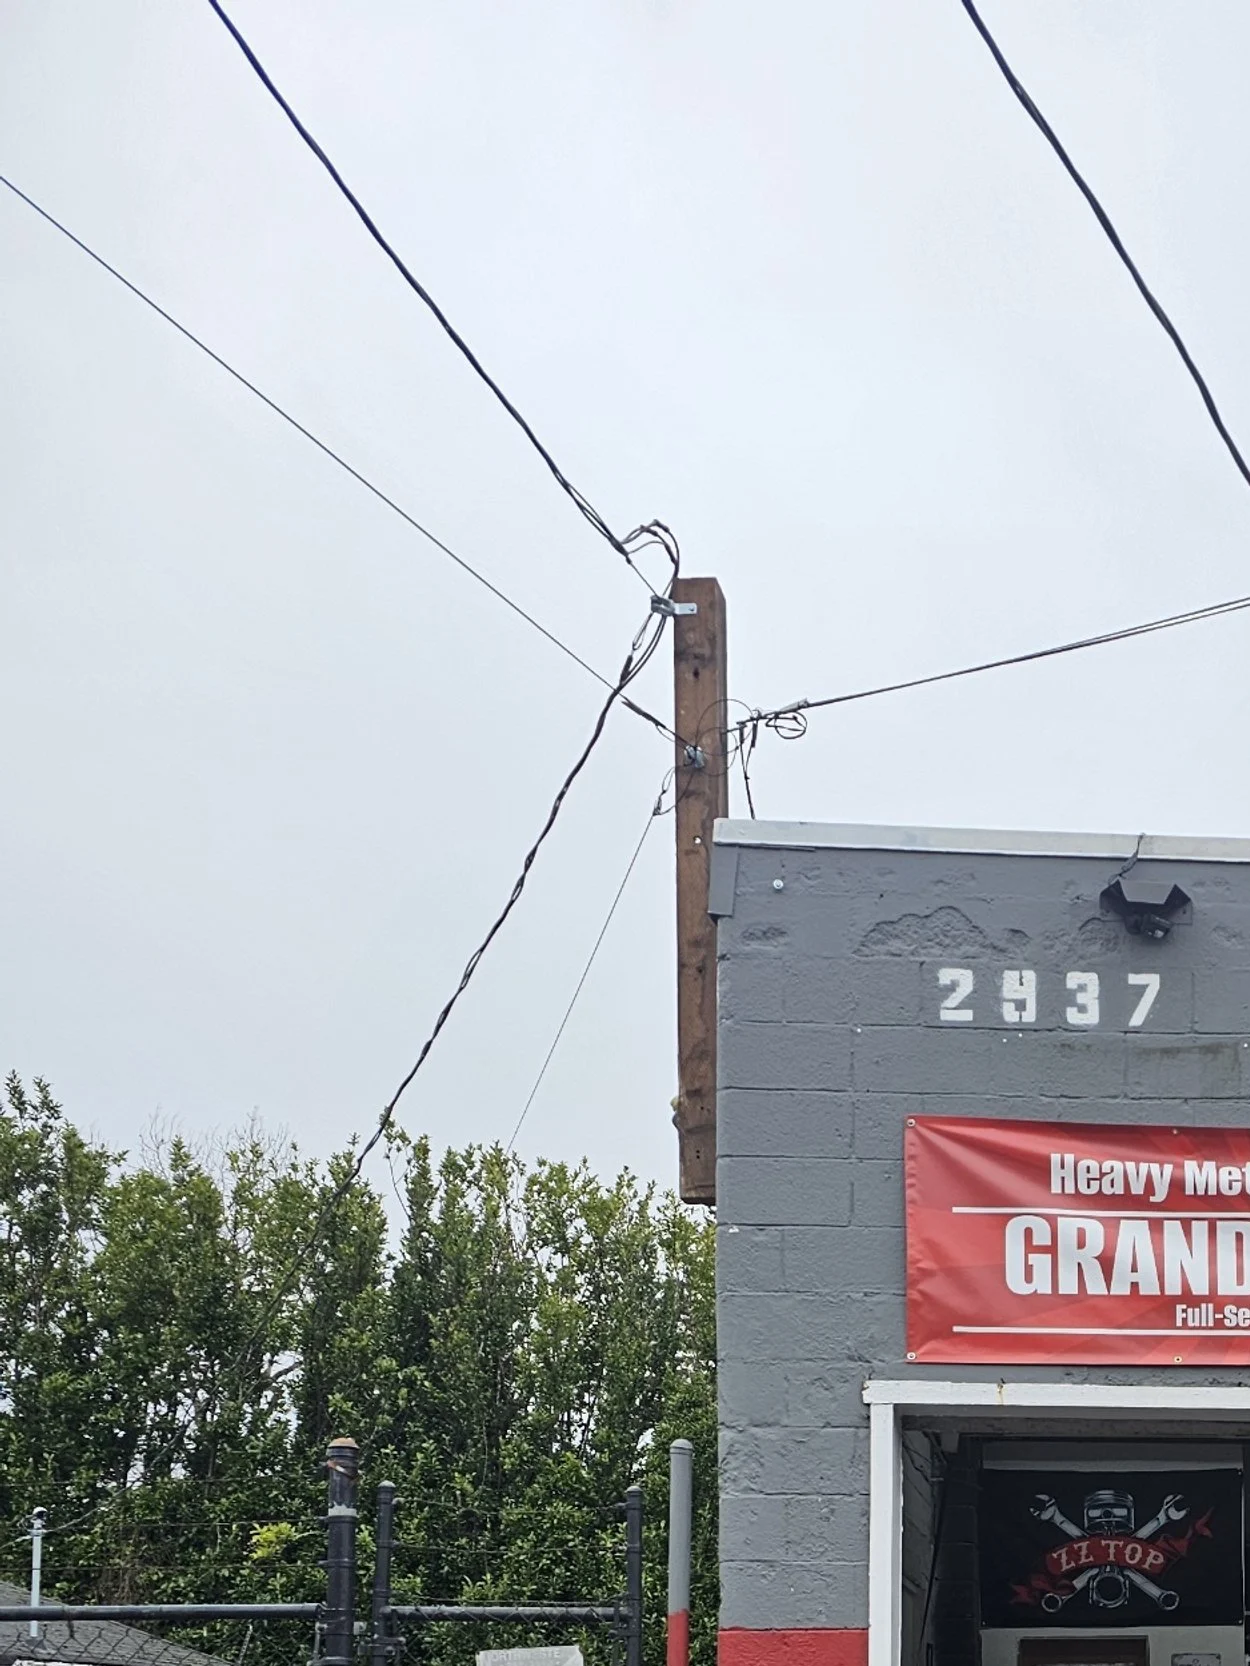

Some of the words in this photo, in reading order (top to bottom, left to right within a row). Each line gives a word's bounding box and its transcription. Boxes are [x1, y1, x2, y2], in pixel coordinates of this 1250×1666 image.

[937, 968, 1160, 1027] 2937
[1049, 1152, 1174, 1203] Heavy
[1052, 1541, 1094, 1573] ZZ
[1101, 1539, 1165, 1571] TOP
